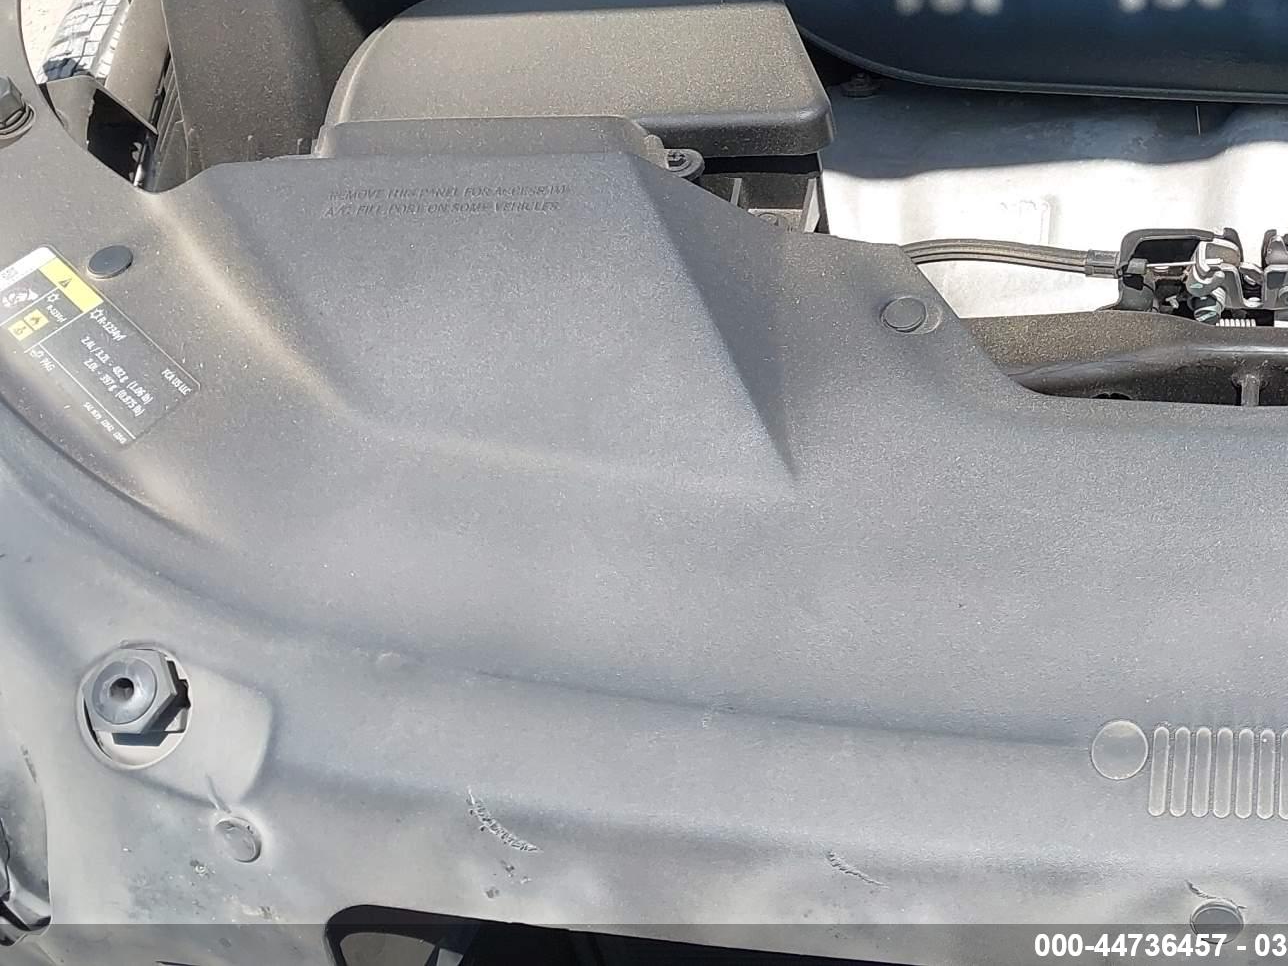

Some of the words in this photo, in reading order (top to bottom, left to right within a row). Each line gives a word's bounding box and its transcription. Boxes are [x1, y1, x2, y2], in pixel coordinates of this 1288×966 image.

[463, 185, 491, 197] FOR
[96, 315, 127, 342] R-1234yf
[161, 368, 176, 381] FCA
[178, 383, 193, 395] LLC
